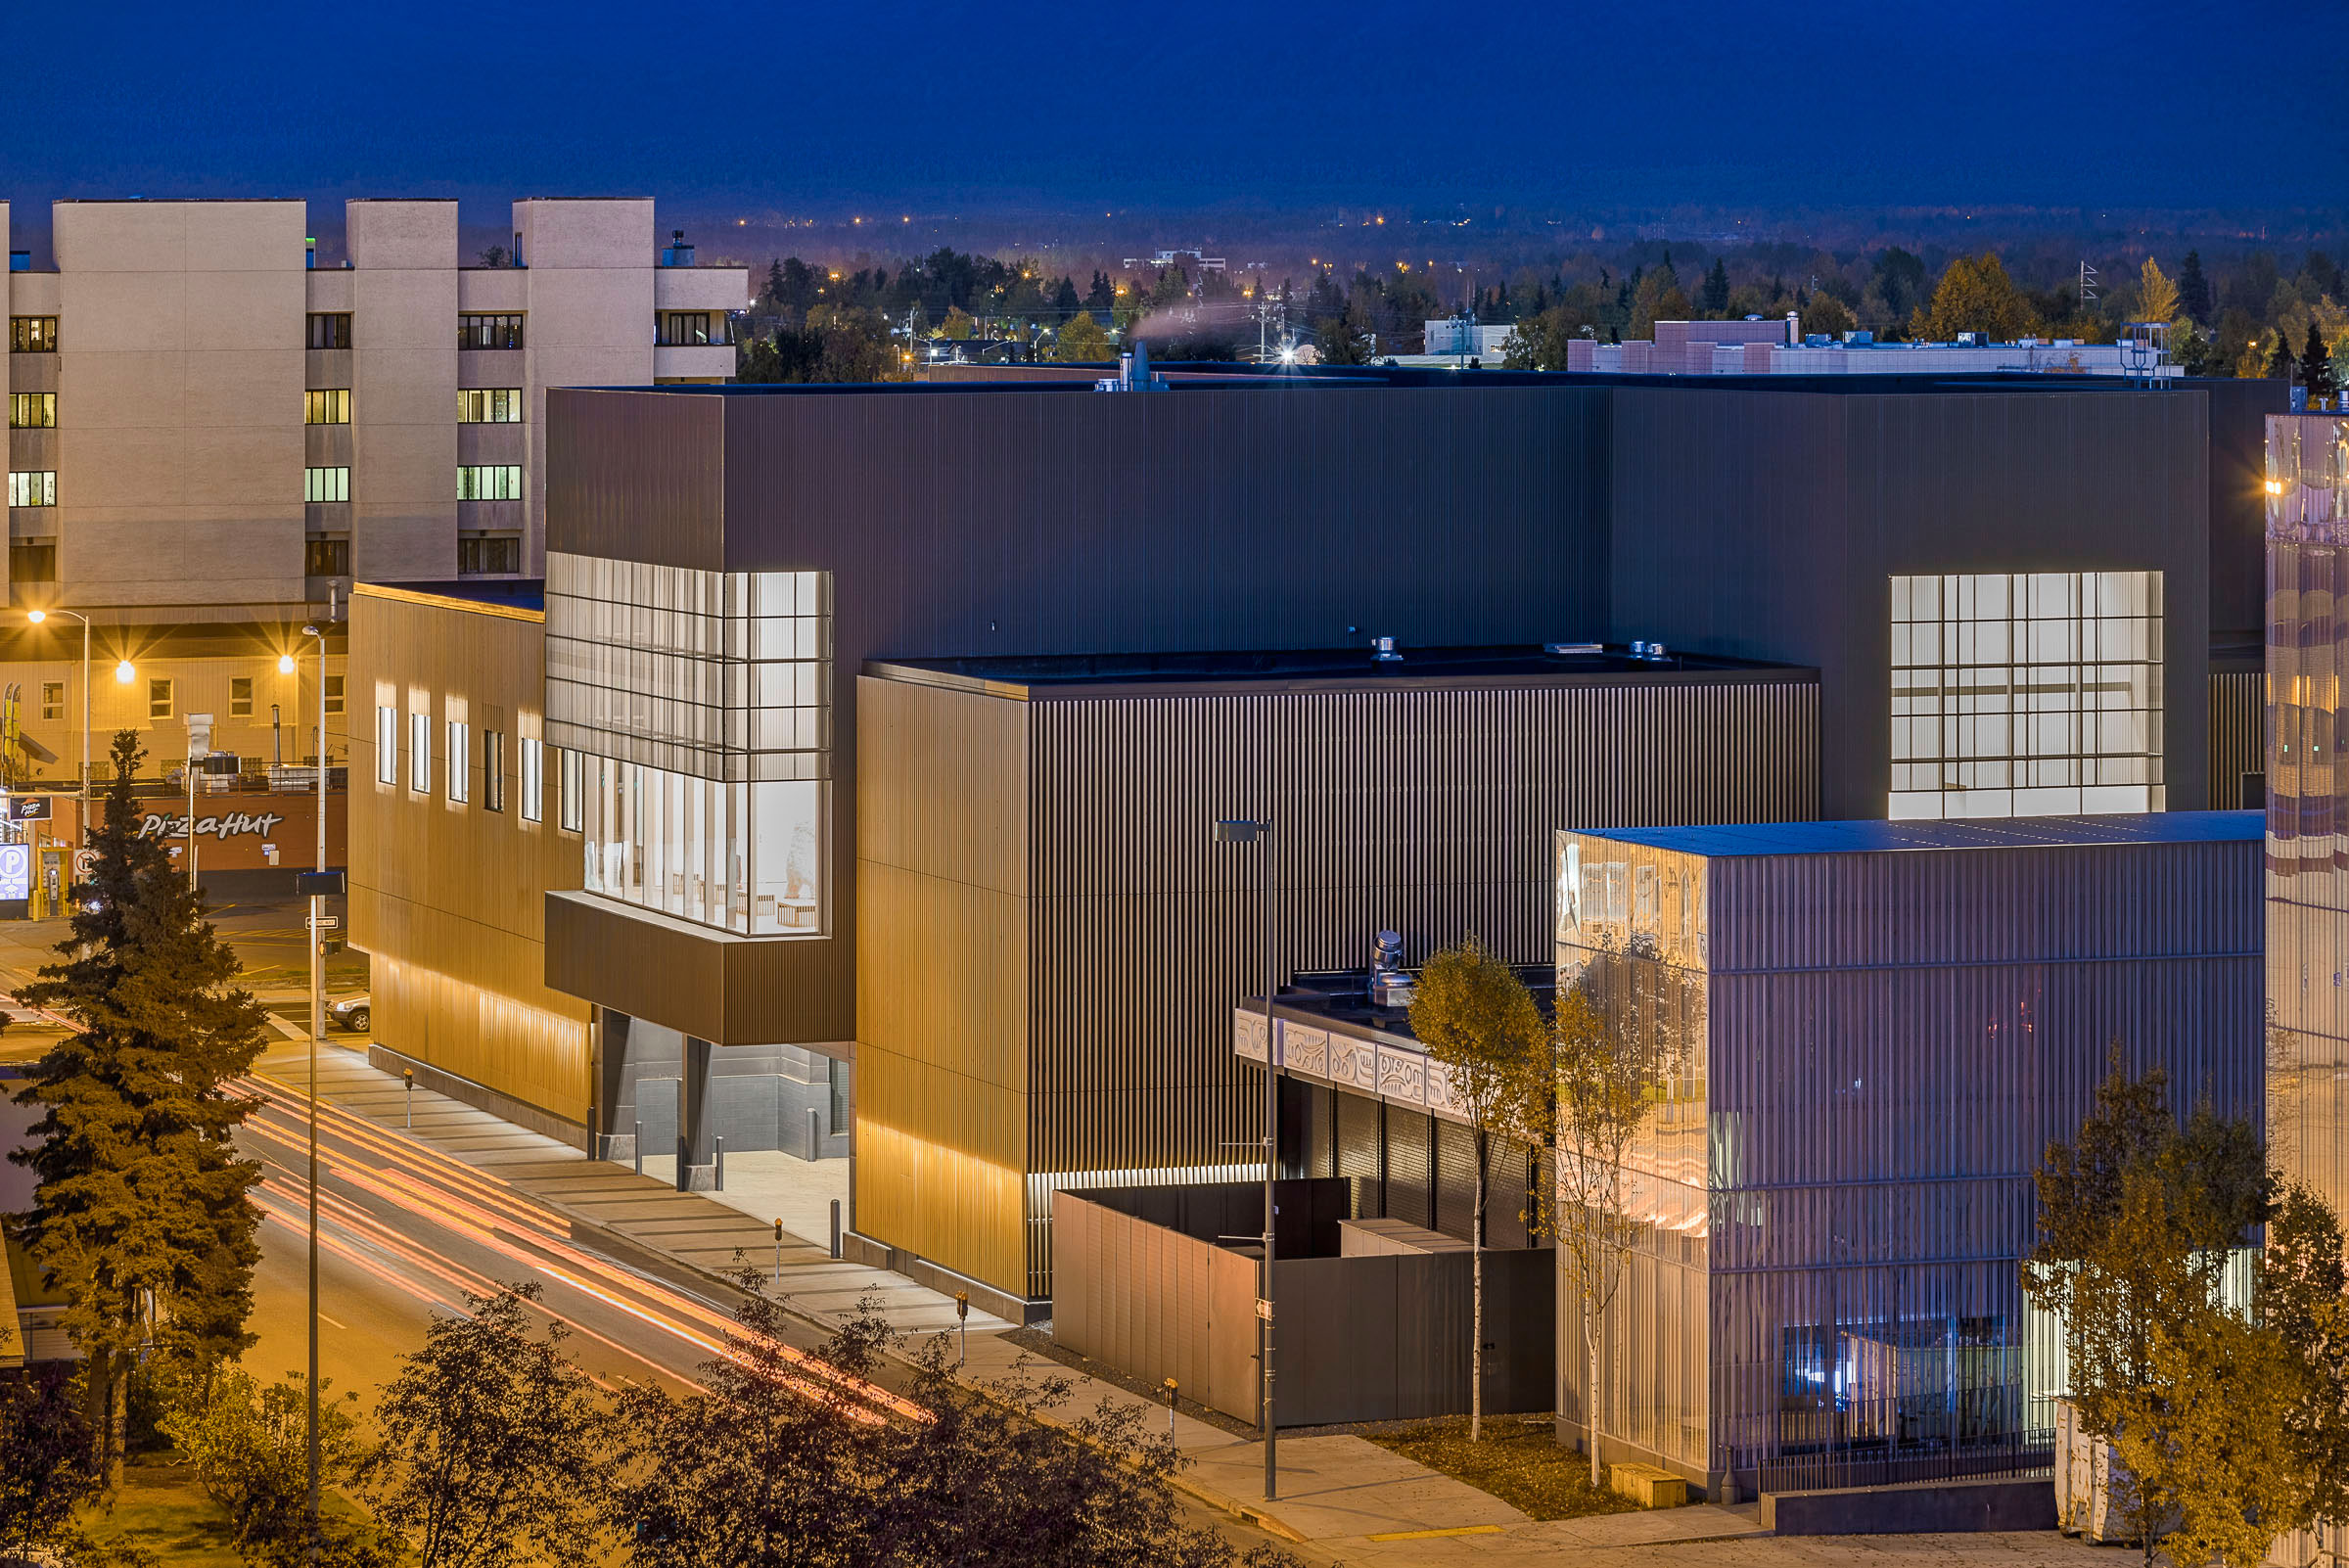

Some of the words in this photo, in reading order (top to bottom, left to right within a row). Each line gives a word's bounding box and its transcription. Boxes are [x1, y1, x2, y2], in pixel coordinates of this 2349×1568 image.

[21, 803, 41, 814] Pizza
[23, 807, 39, 816] Hut
[6, 852, 20, 873] P
